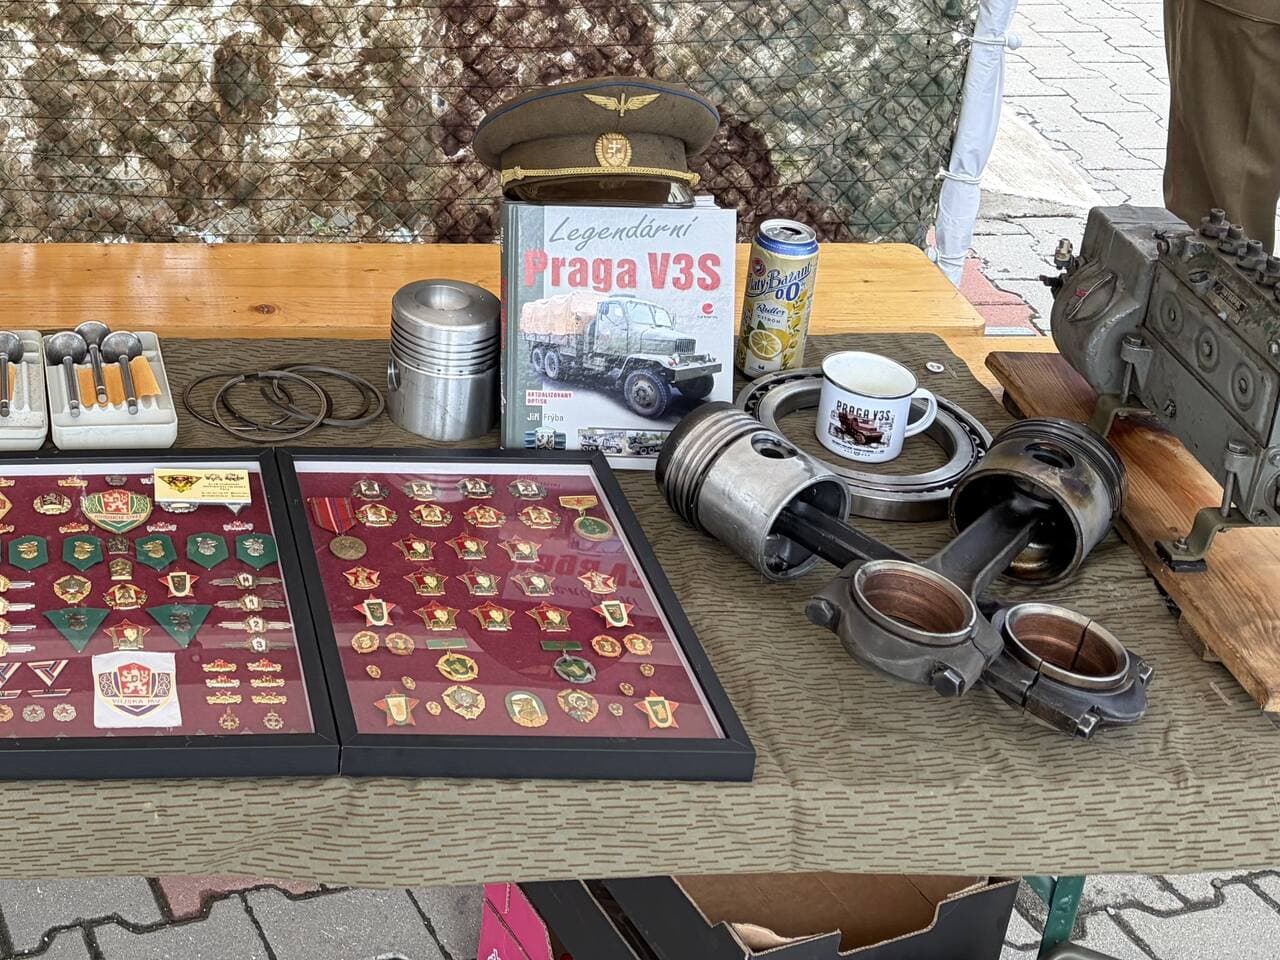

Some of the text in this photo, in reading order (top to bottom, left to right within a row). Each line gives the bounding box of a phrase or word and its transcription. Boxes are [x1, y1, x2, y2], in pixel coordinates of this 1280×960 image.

[549, 213, 698, 251] Legendární
[524, 248, 721, 292] Praga V3S
[836, 400, 891, 421] PRAGA V3S
